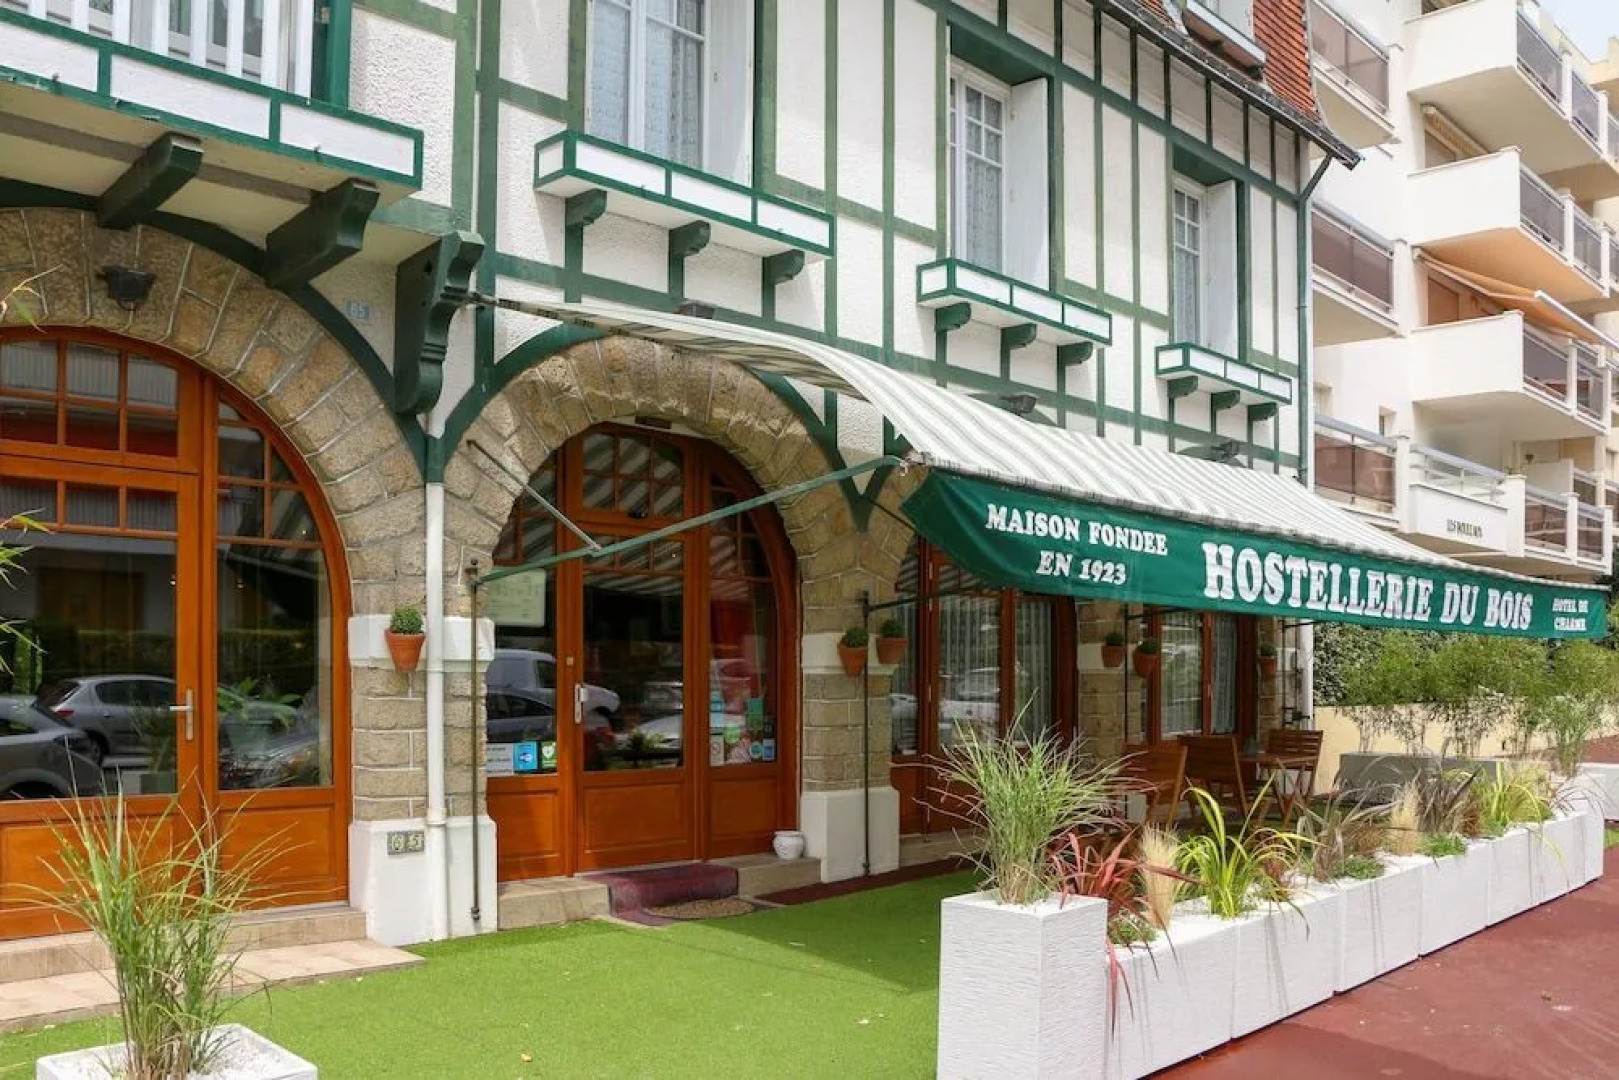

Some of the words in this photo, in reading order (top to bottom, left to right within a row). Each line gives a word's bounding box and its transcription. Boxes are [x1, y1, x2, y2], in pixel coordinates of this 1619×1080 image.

[985, 503, 1081, 542] MAISON
[1088, 521, 1169, 556] FONDEE
[1036, 550, 1074, 577] EN
[1078, 558, 1127, 586] 1923
[1202, 541, 1434, 622] HOSTELLERIE
[1439, 582, 1480, 626] DU
[1483, 588, 1534, 631] BOIS
